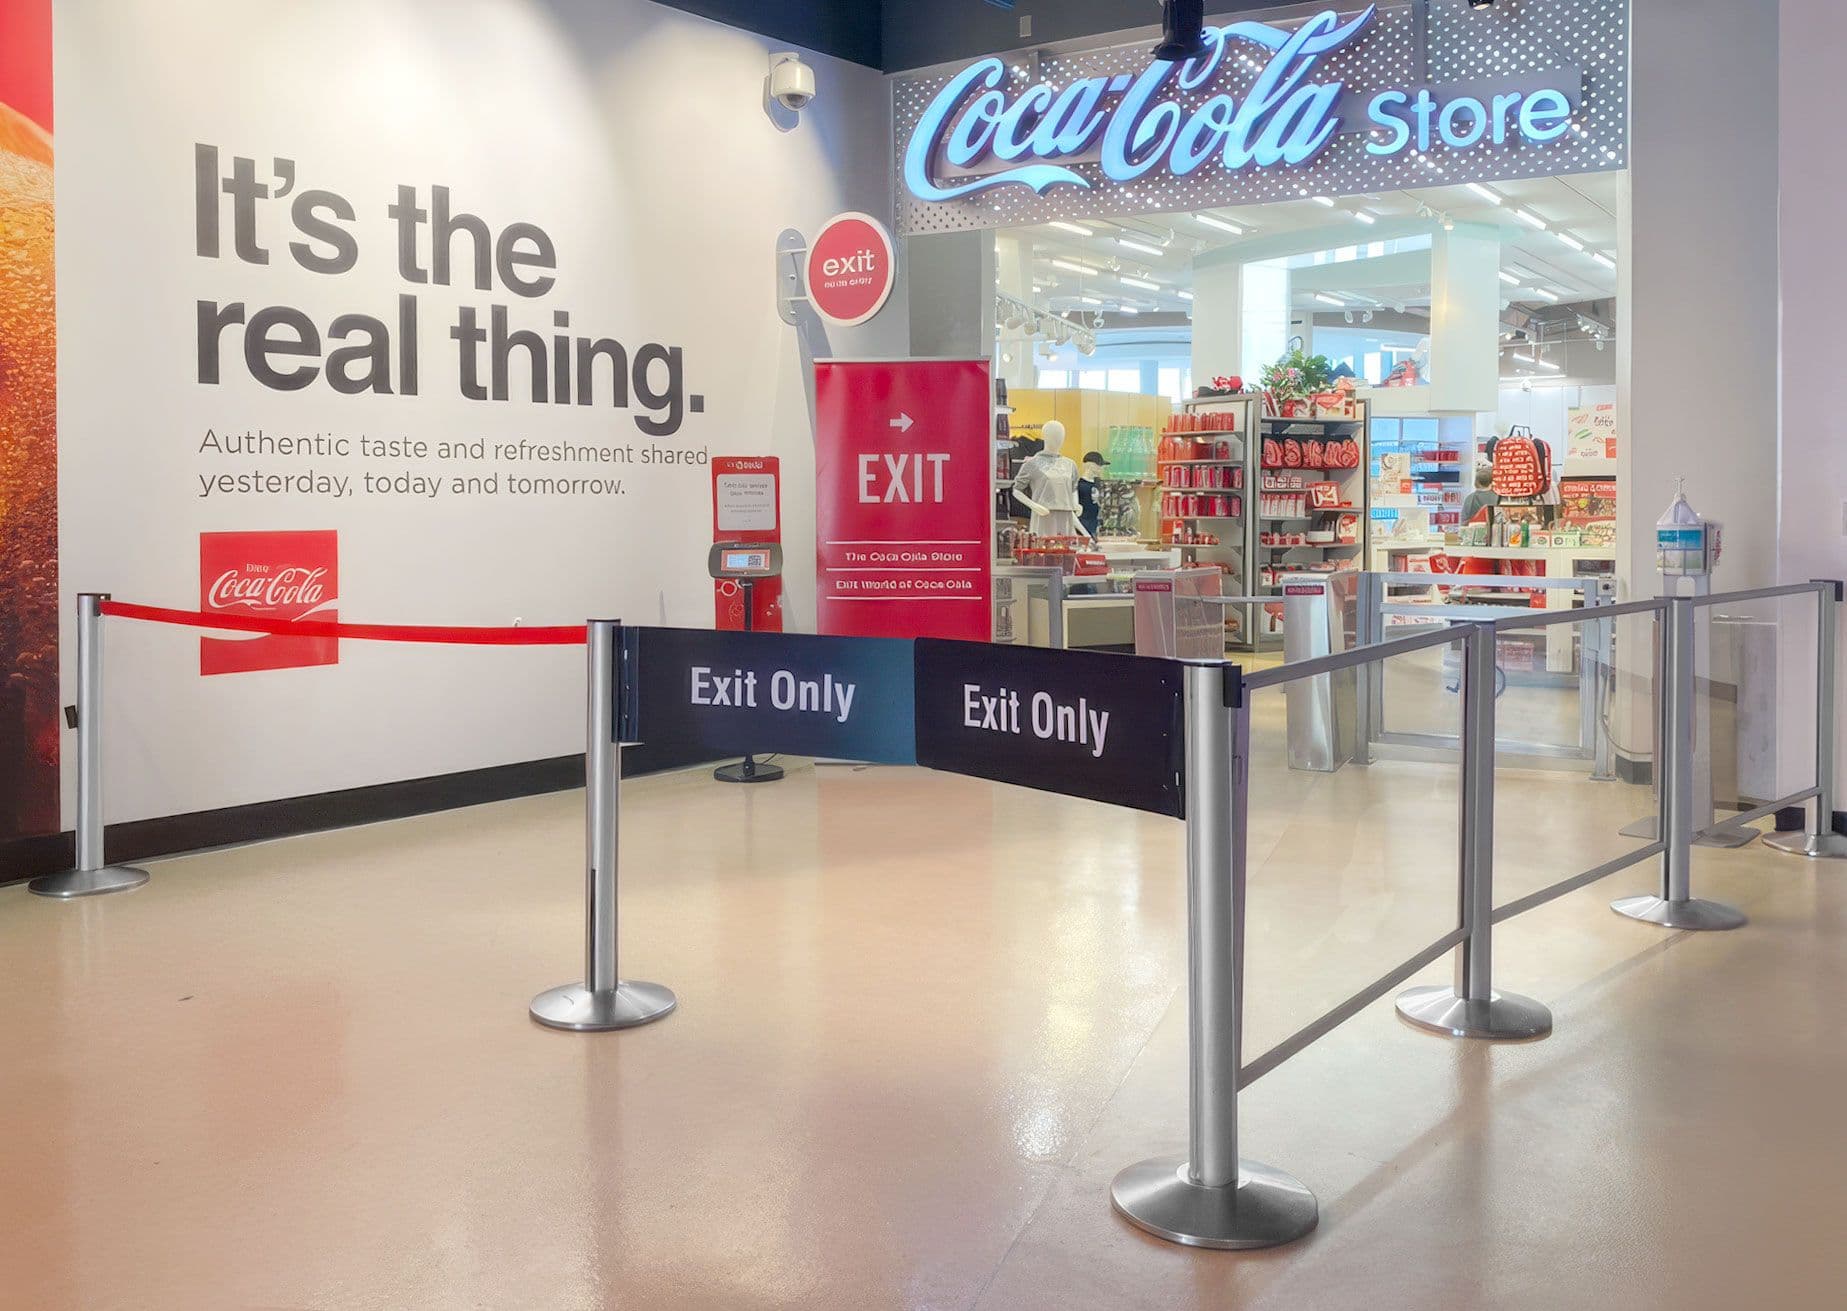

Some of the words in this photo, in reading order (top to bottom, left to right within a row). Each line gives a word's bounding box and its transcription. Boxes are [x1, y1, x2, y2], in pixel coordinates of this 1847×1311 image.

[904, 2, 1376, 201] Coca-Cola
[1365, 87, 1571, 156] Store
[388, 185, 557, 299] the
[822, 249, 876, 277] exit
[197, 294, 418, 397] real
[450, 304, 704, 436] thing.
[199, 428, 350, 456] Authentic
[360, 434, 428, 458] taste
[438, 438, 485, 460] and
[494, 439, 634, 464] refreshment
[640, 443, 708, 465] shared
[199, 470, 353, 498] yesterday,
[364, 471, 442, 498] today
[452, 472, 498, 495] and
[507, 474, 626, 495] tomorrow.
[858, 453, 951, 504] EXIT
[208, 566, 328, 610] Coca-Cola
[691, 666, 758, 708] Exit
[770, 670, 856, 723] Only
[964, 683, 1021, 734] Exit
[1031, 691, 1110, 758] Only
